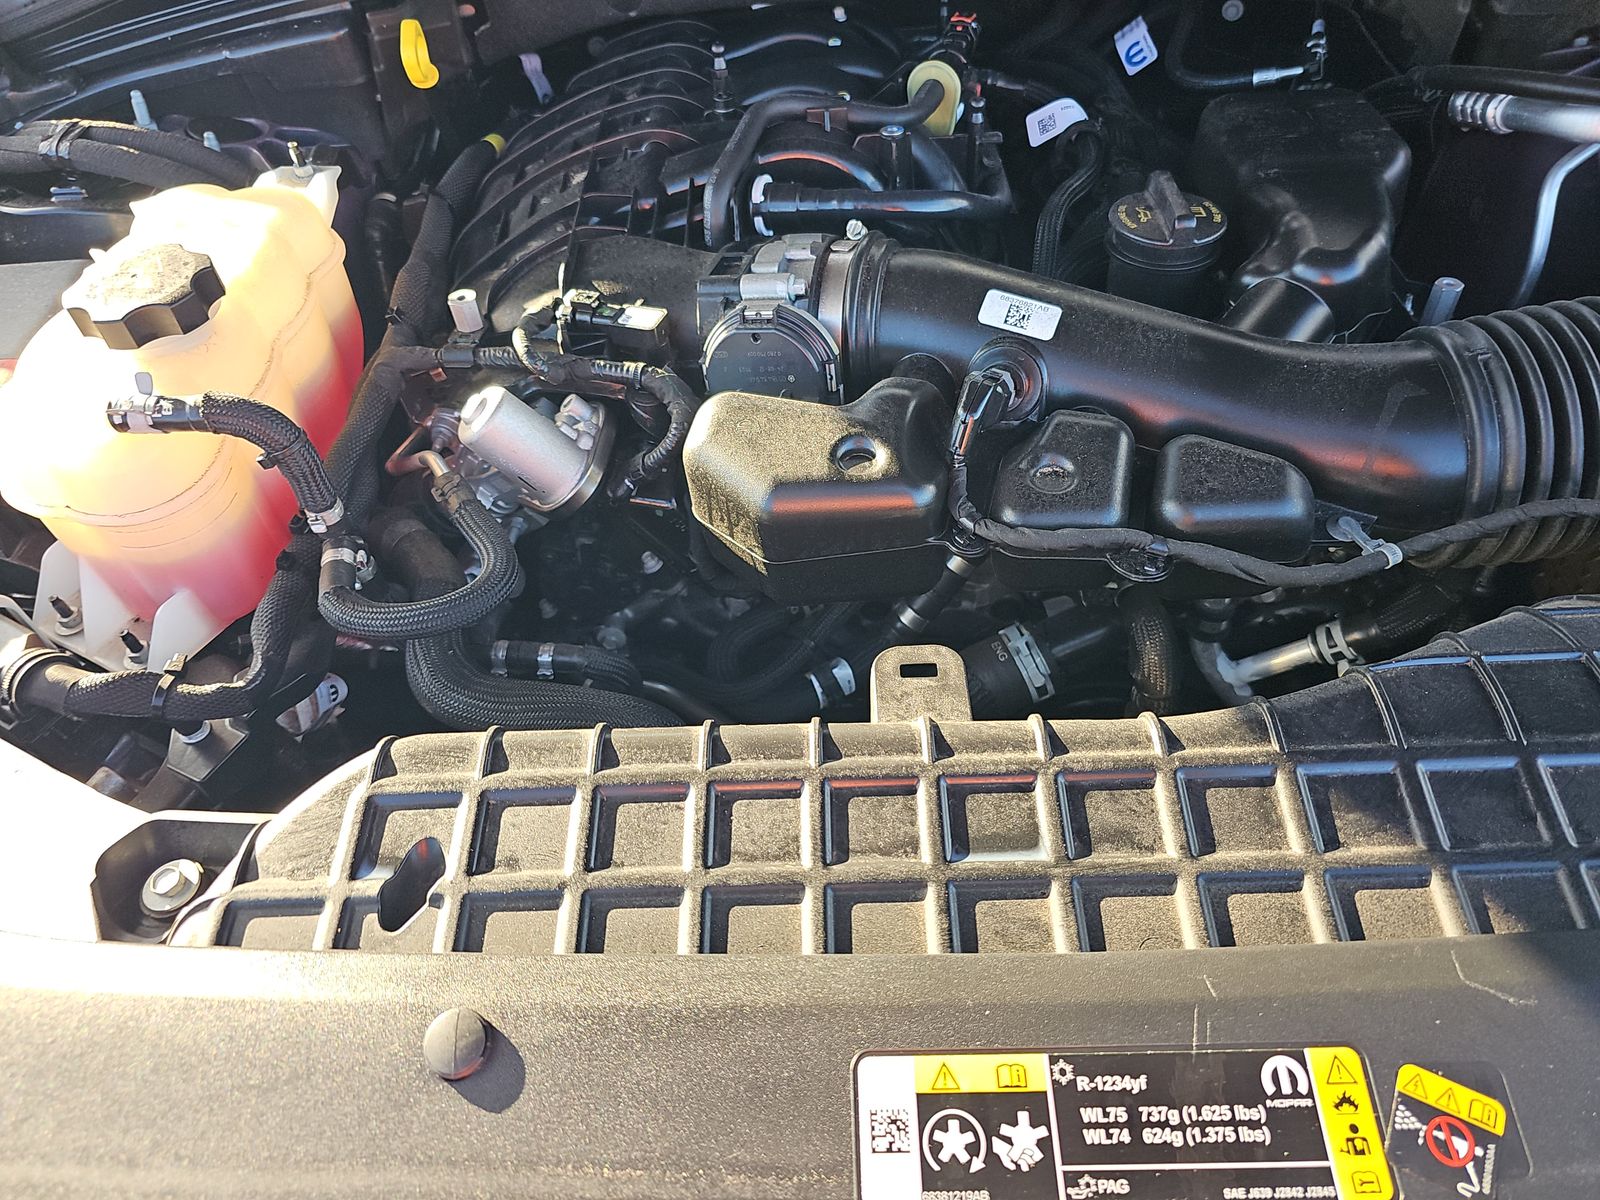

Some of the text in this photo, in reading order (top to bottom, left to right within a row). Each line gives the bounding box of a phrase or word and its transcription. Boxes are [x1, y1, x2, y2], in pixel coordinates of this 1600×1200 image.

[991, 641, 1008, 662] ENG
[1075, 1074, 1148, 1094] R-1234yf
[1265, 1098, 1312, 1108] MOPAR
[1080, 1104, 1267, 1125] WL75 737g (1.625 lbs)
[1082, 1126, 1272, 1147] WL74 624g (1.375 lbs)
[1097, 1179, 1130, 1194] PAG
[1222, 1187, 1247, 1199] SAE
